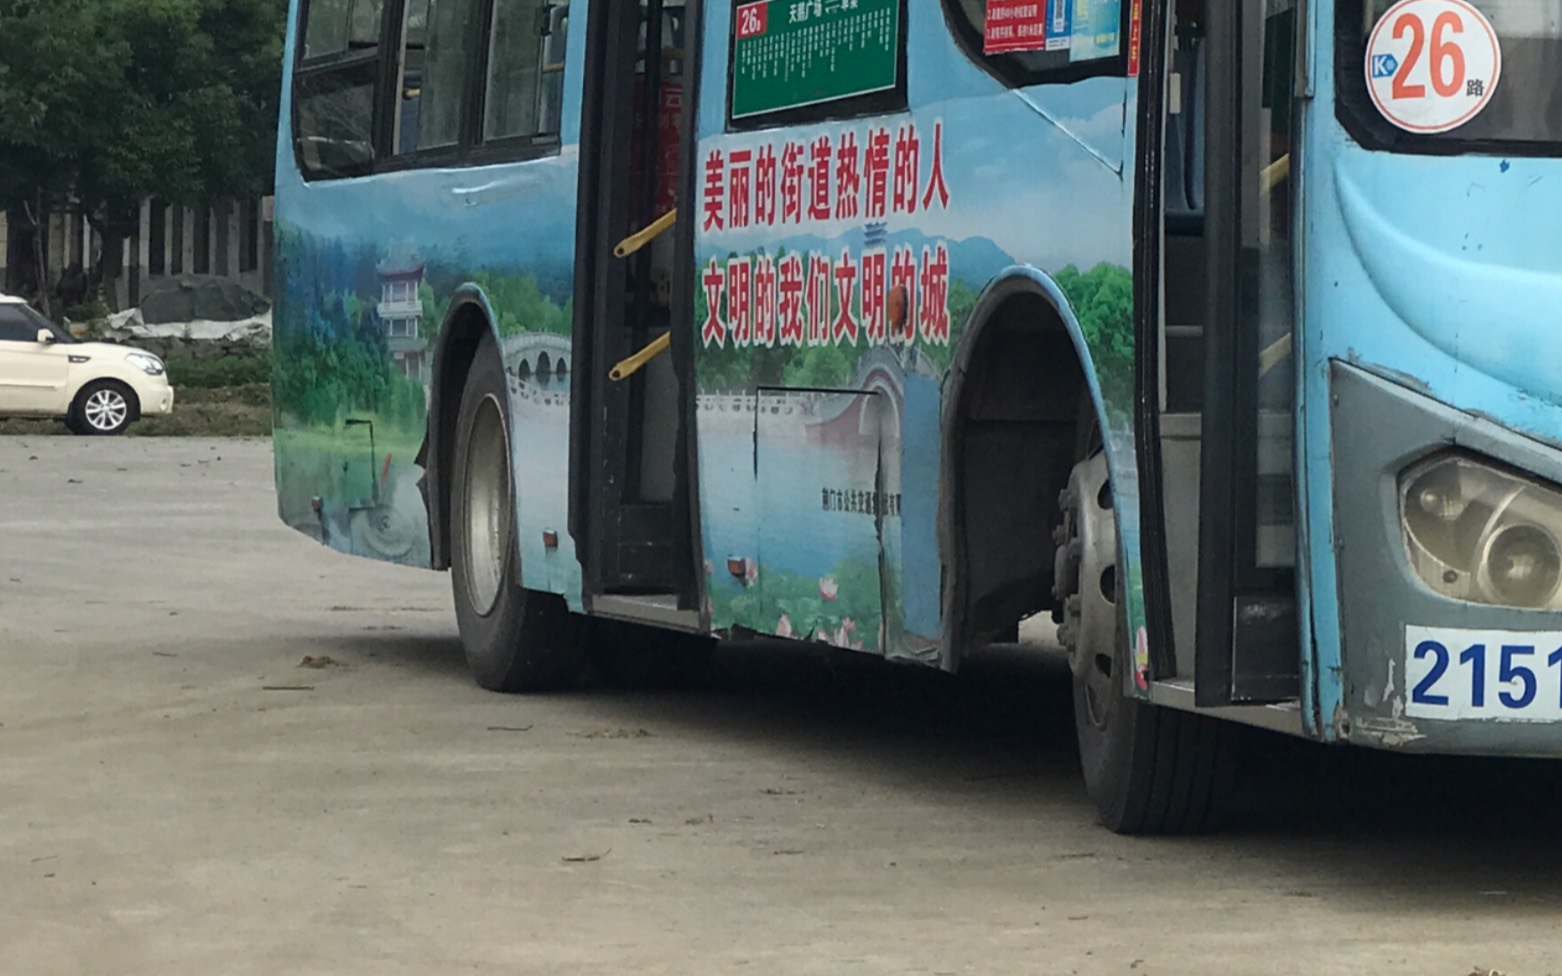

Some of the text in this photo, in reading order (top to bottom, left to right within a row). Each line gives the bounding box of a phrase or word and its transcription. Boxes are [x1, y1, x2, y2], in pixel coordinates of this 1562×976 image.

[703, 122, 949, 232] 美丽的街道热情的人
[702, 245, 950, 344] 文明的我们文明的城
